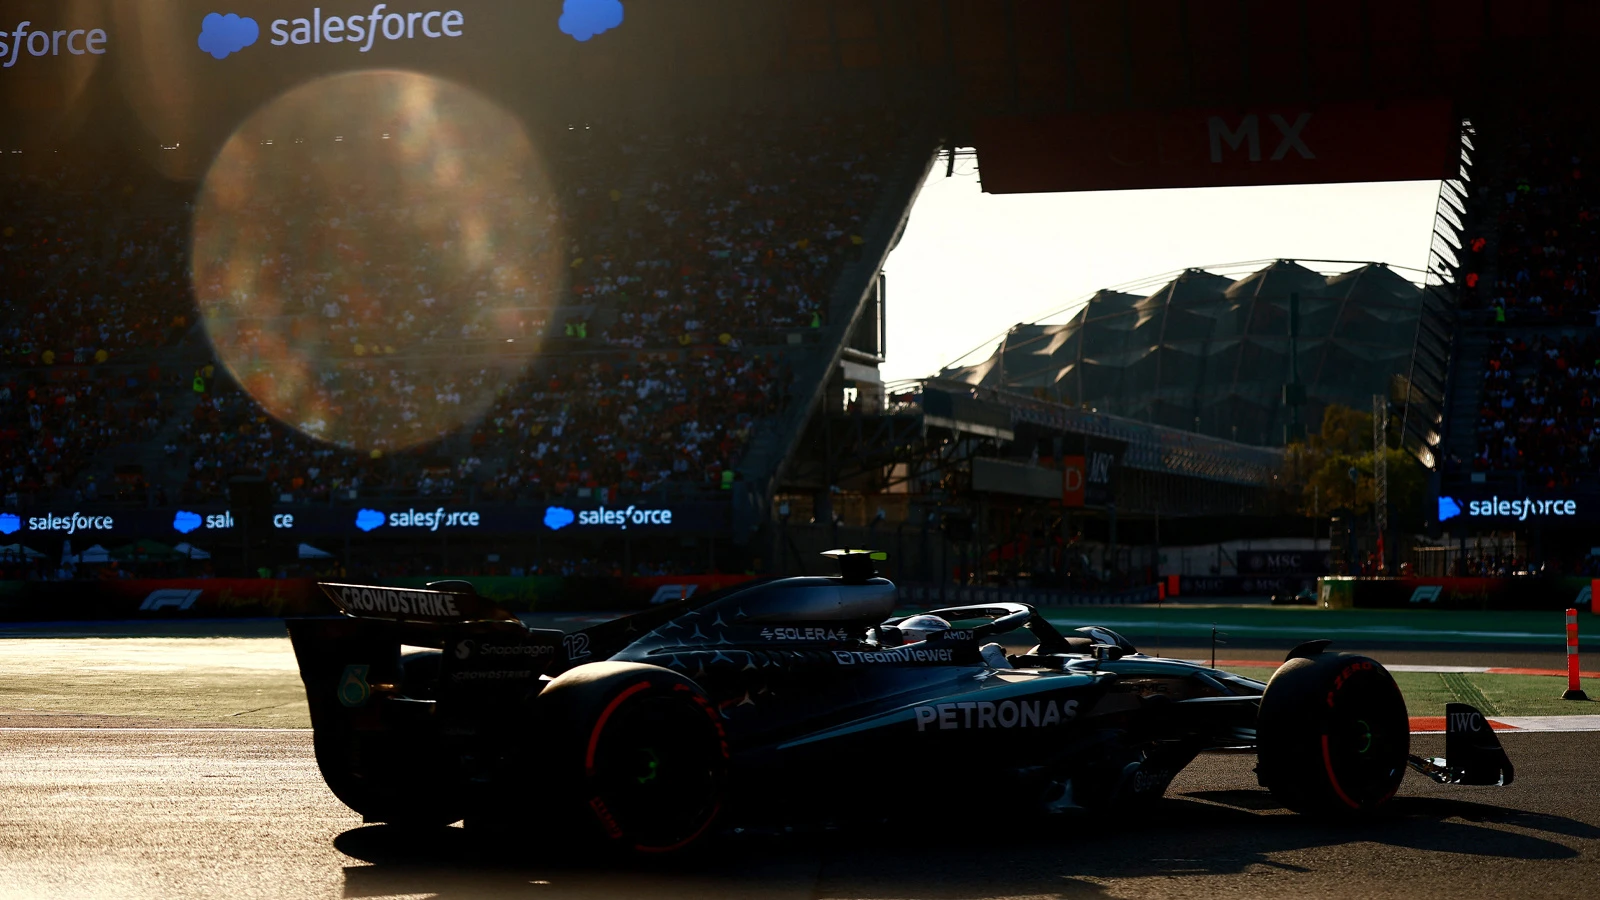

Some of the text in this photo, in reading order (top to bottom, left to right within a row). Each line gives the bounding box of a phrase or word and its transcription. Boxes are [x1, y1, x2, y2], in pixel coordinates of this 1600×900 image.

[270, 4, 464, 52] salesforce
[1065, 466, 1082, 492] D
[1469, 495, 1577, 521] salesforce
[29, 512, 114, 535] salesforce
[1267, 553, 1301, 568] MSC
[340, 587, 461, 617] CROWDSTRIKE
[773, 627, 838, 641] SOLERA
[943, 629, 967, 641] AMD
[479, 641, 555, 660] Snapdragon
[562, 632, 593, 661] 12
[857, 648, 953, 665] TeamViewer
[454, 668, 532, 681] CROWDSTRIKE
[914, 700, 1080, 732] PETRONAS
[1449, 712, 1482, 732] IWC
